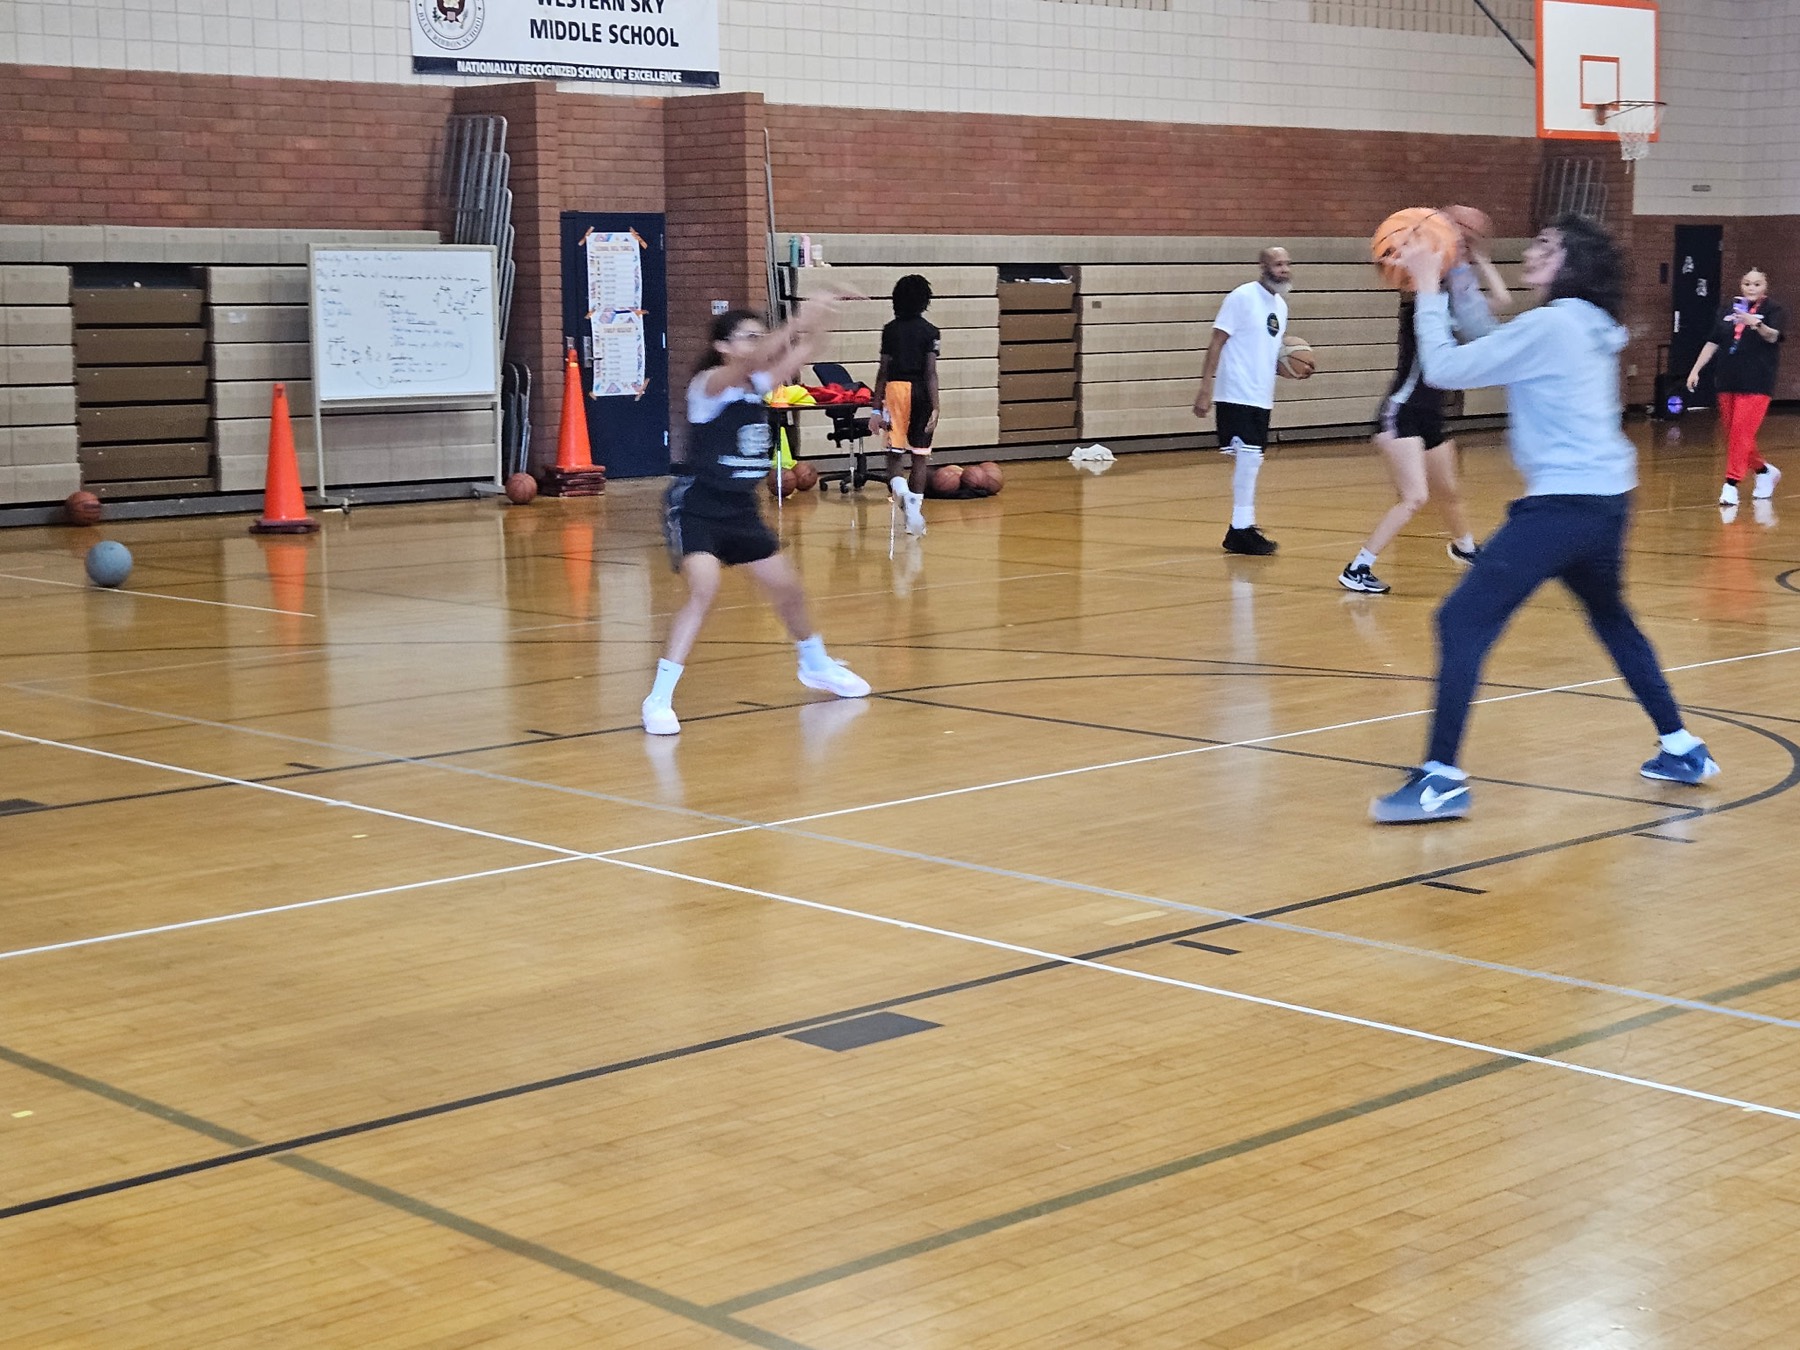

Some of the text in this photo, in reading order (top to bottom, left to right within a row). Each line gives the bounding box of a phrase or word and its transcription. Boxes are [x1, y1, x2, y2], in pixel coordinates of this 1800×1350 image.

[631, 0, 664, 13] SKY
[530, 18, 680, 47] MIDDLE SCHOOL
[457, 60, 682, 83] NATIONALLY RECOGNIZED SCHOOL OF EXCELLENCE
